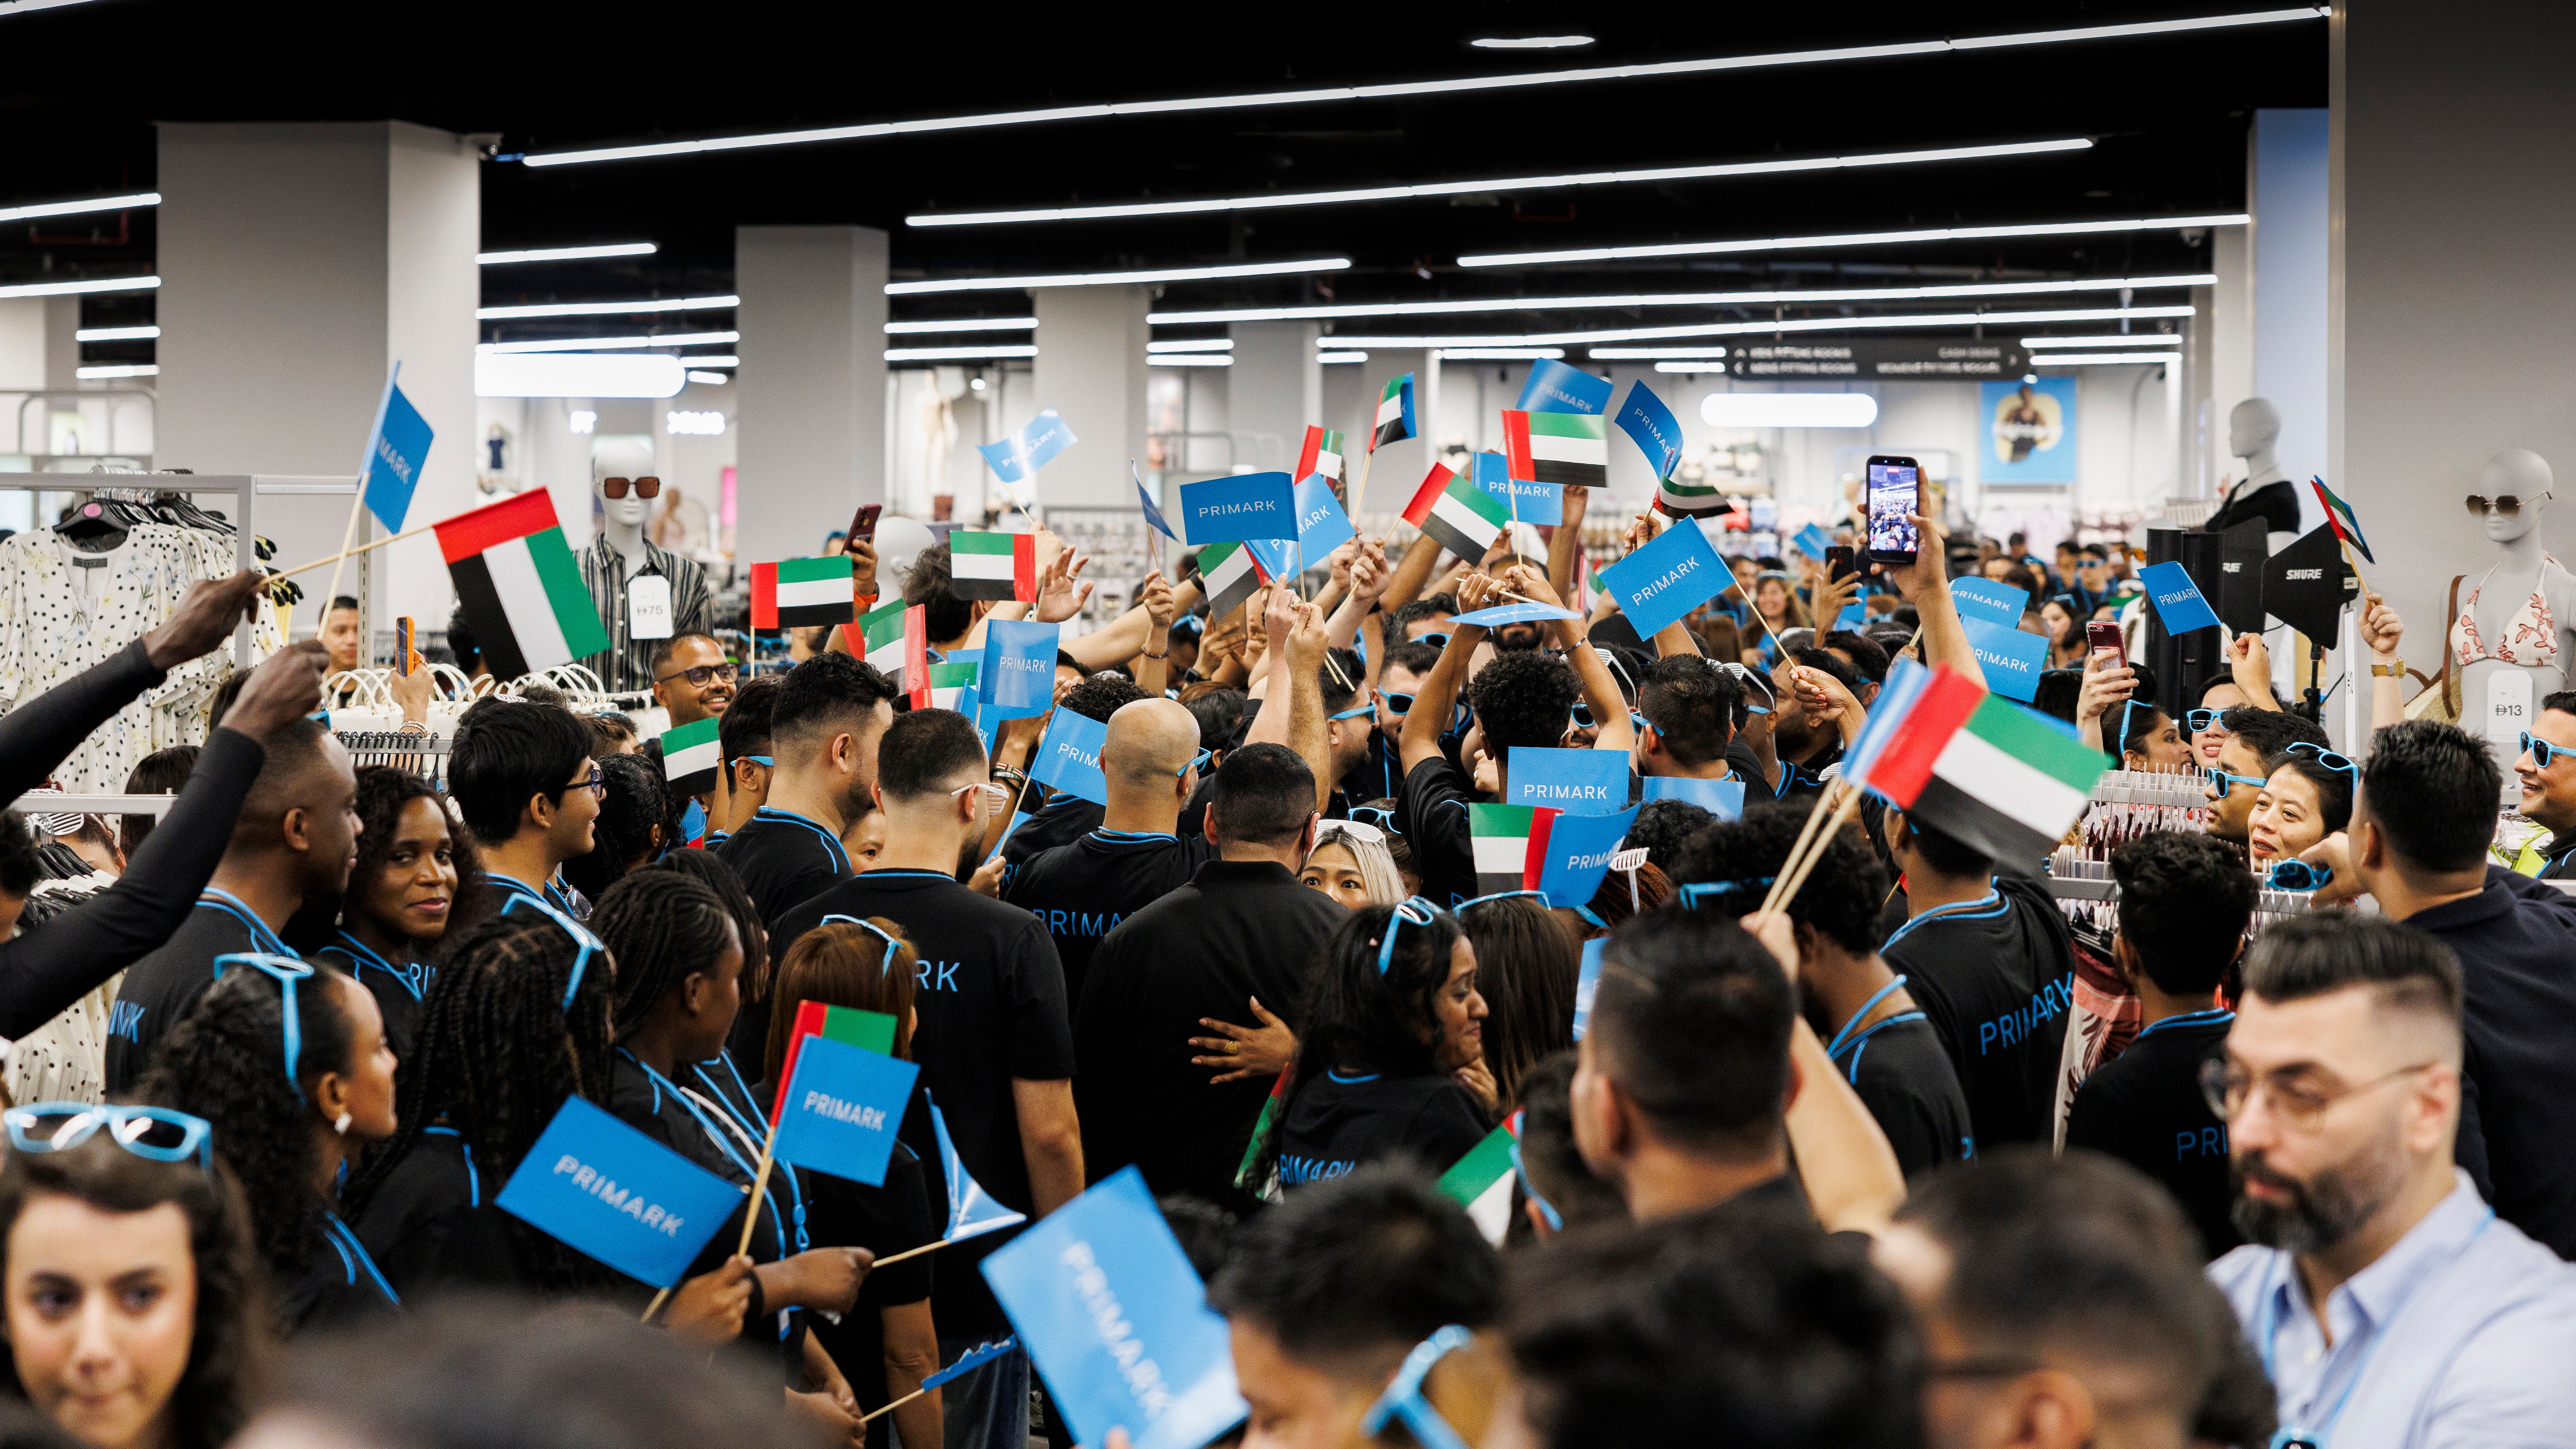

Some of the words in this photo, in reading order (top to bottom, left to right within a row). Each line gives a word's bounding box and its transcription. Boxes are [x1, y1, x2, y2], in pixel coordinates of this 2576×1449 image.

[1635, 408, 1671, 458] PRIMAR
[379, 434, 412, 484] MARK
[1489, 481, 1551, 497] PRIMARK
[1199, 500, 1275, 518] PRIMARK
[1632, 556, 1700, 606] PRIMARK
[2286, 569, 2323, 580] SHURE
[1951, 590, 2010, 612] PRIMARK
[2158, 588, 2199, 606] PRIMARK
[1000, 657, 1046, 673] PRIMARK
[1971, 647, 2029, 673] RIMARK
[1058, 742, 1101, 769] PRIM
[1524, 784, 1608, 800] PRIMARK
[1033, 909, 1130, 937] PRIMA
[804, 1090, 887, 1132] PRIMARK
[553, 1154, 685, 1238] PRIMARK
